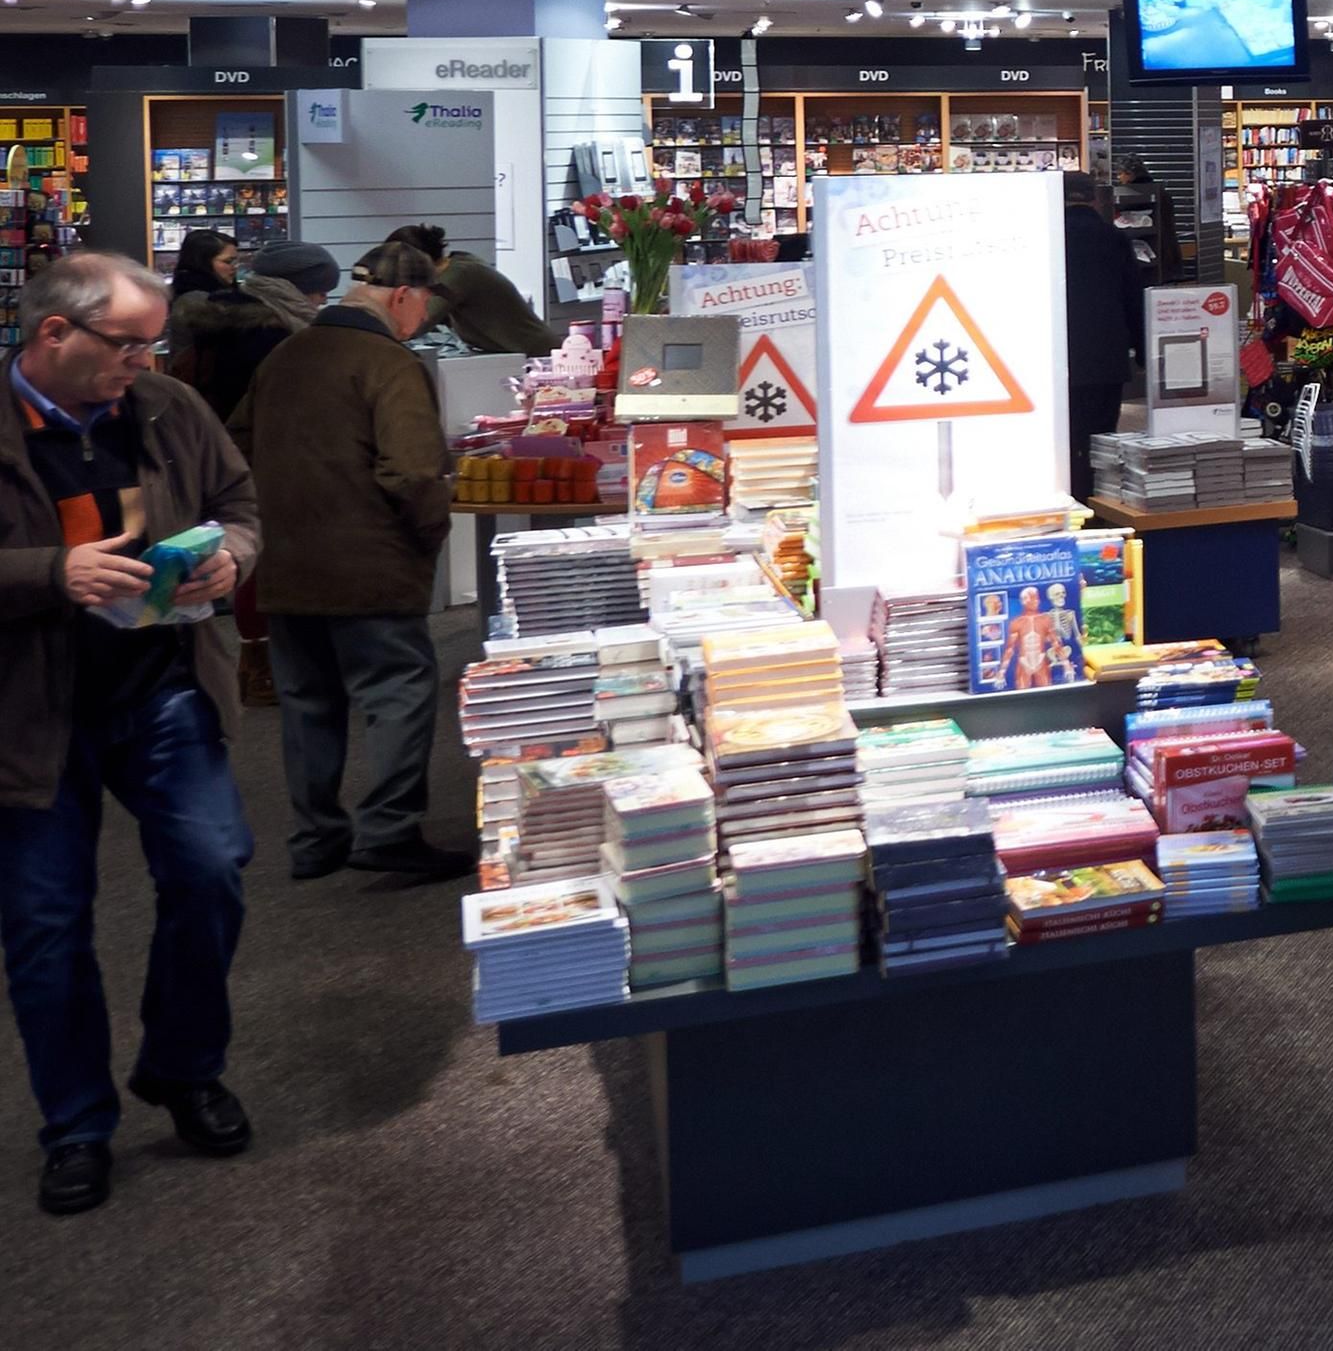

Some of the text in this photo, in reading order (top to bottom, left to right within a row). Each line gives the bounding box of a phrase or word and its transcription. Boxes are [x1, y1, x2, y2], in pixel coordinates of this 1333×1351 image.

[214, 71, 250, 83] DVD
[436, 59, 531, 79] eReader
[859, 70, 889, 82] DVD
[1001, 70, 1030, 82] DVD
[430, 104, 482, 118] Thalia
[701, 277, 802, 309] Achtung:
[740, 308, 816, 329] eisrutsc
[974, 561, 1076, 586] ANATOMIE
[1175, 756, 1287, 780] OBSTKUCHEN-SET
